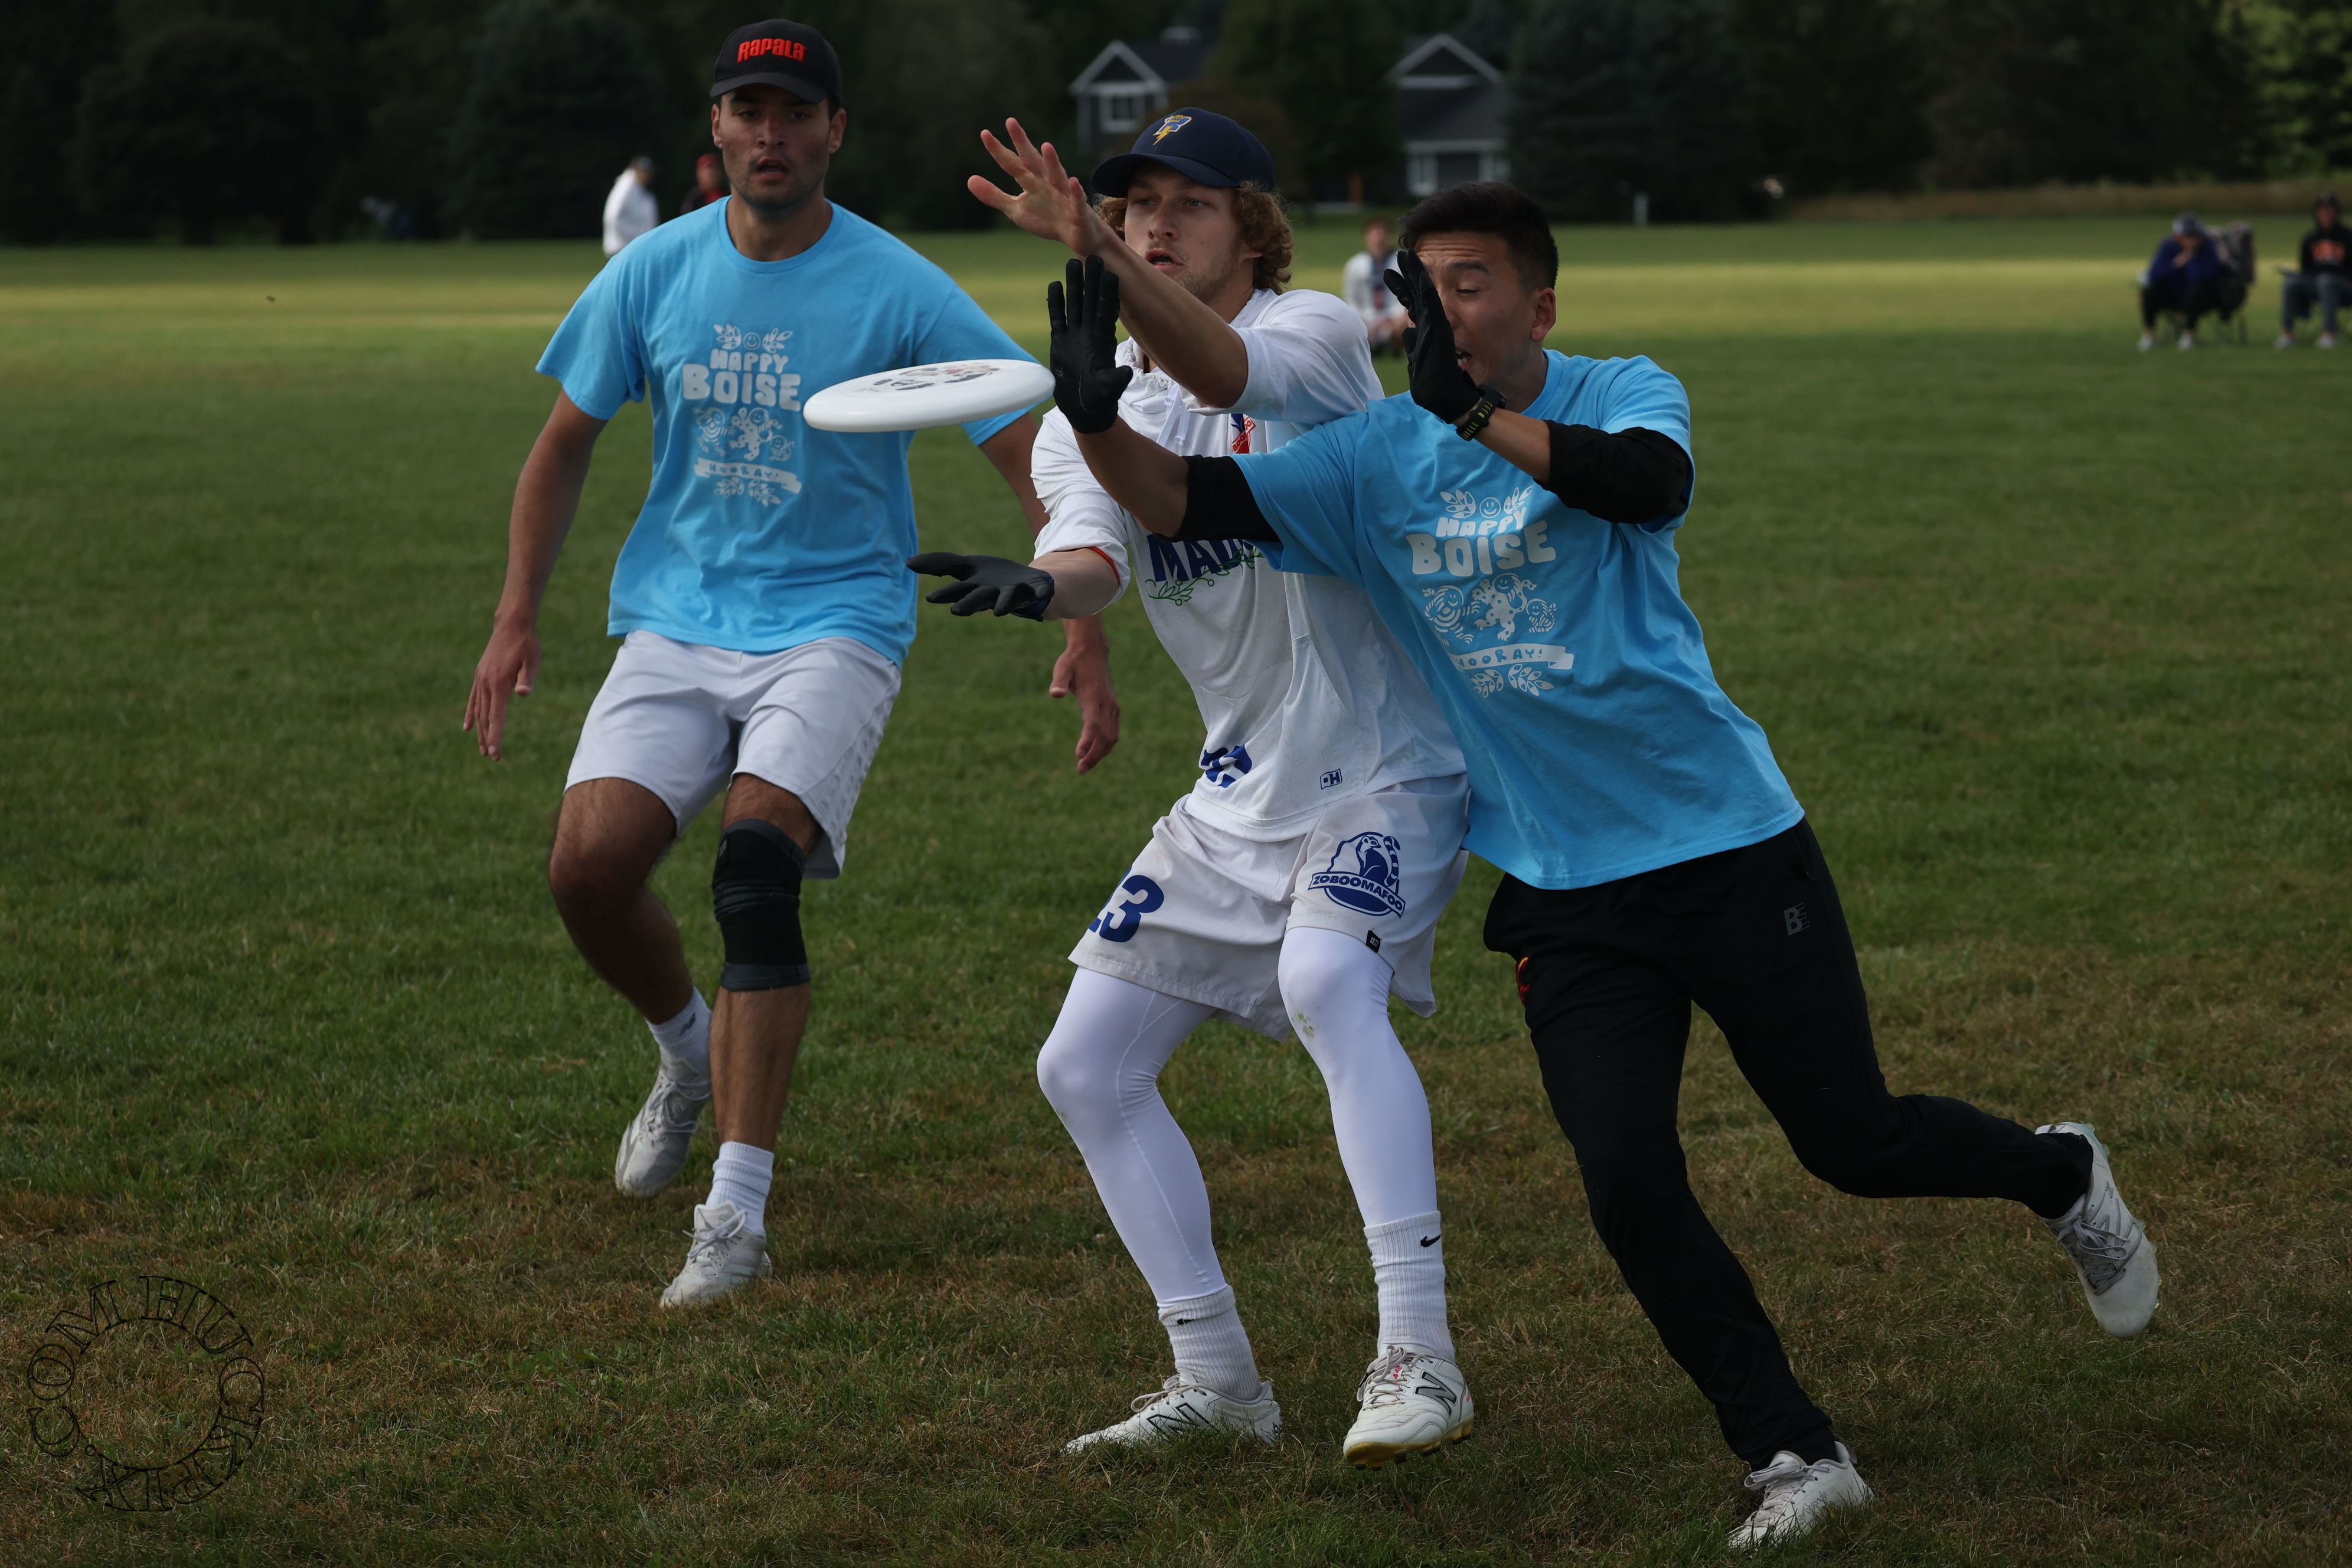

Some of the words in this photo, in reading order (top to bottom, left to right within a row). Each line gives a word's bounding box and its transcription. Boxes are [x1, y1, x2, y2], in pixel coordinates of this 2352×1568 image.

[710, 348, 789, 374] HAPPY
[682, 363, 801, 412] BOISE
[710, 463, 779, 481] HOORAY!
[1436, 507, 1527, 537] HAPPY
[1406, 520, 1557, 577] BOISE
[1089, 867, 1164, 942] 3
[1312, 875, 1403, 911] ZOBOOMAFOO
